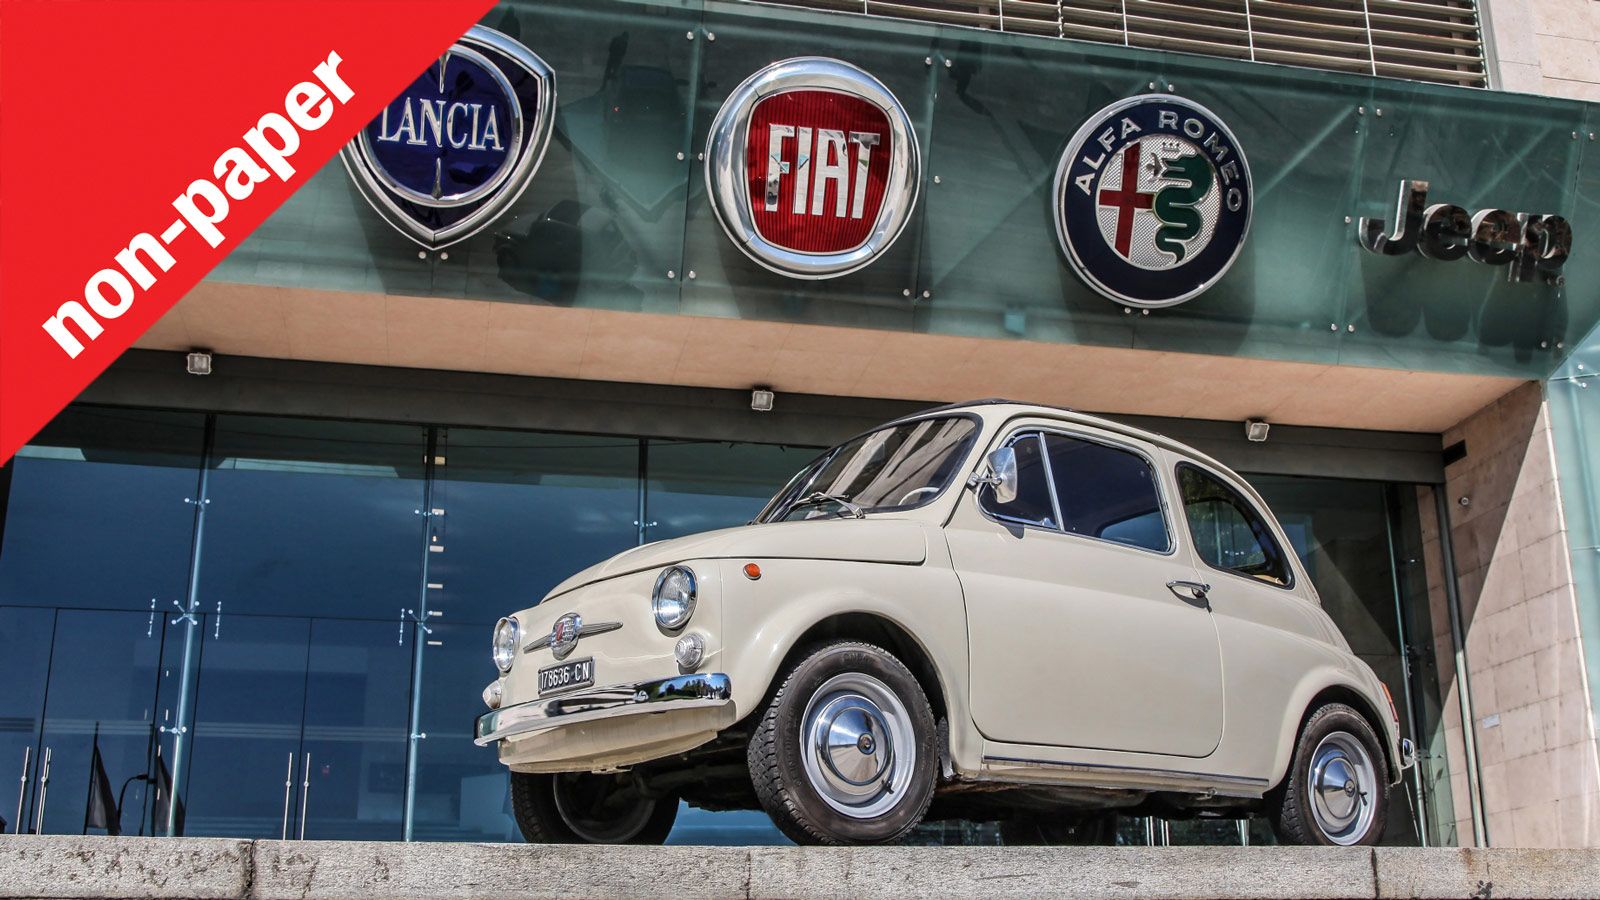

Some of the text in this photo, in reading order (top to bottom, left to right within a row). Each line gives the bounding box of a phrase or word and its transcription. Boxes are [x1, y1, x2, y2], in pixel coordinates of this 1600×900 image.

[377, 97, 504, 152] LANCIA
[765, 122, 881, 219] FIAT
[1074, 109, 1241, 213] ALFA ROMEO
[1359, 180, 1572, 282] Jeep
[541, 662, 589, 689] 178636 CN
